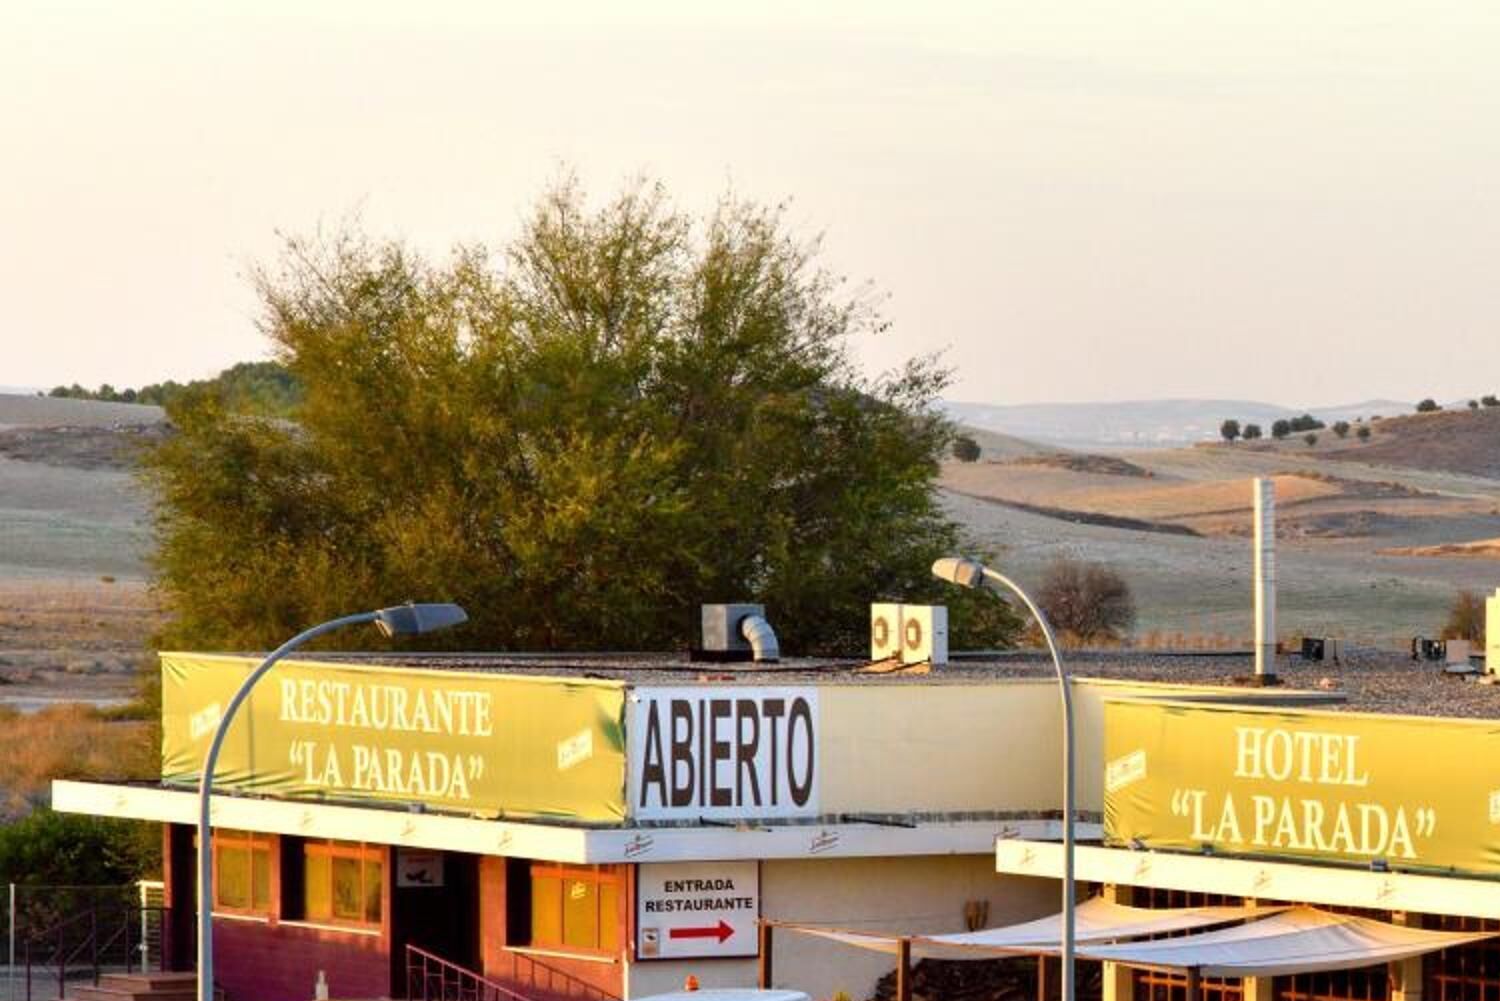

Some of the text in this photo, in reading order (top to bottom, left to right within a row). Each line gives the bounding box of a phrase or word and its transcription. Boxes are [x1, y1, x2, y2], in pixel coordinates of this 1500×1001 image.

[279, 677, 494, 737] RESTAURANTE
[640, 695, 815, 809] ABIERTO
[1233, 726, 1370, 787] HOTEL
[644, 896, 753, 913] RESTAURANTE
[663, 878, 735, 893] ENTRADA
